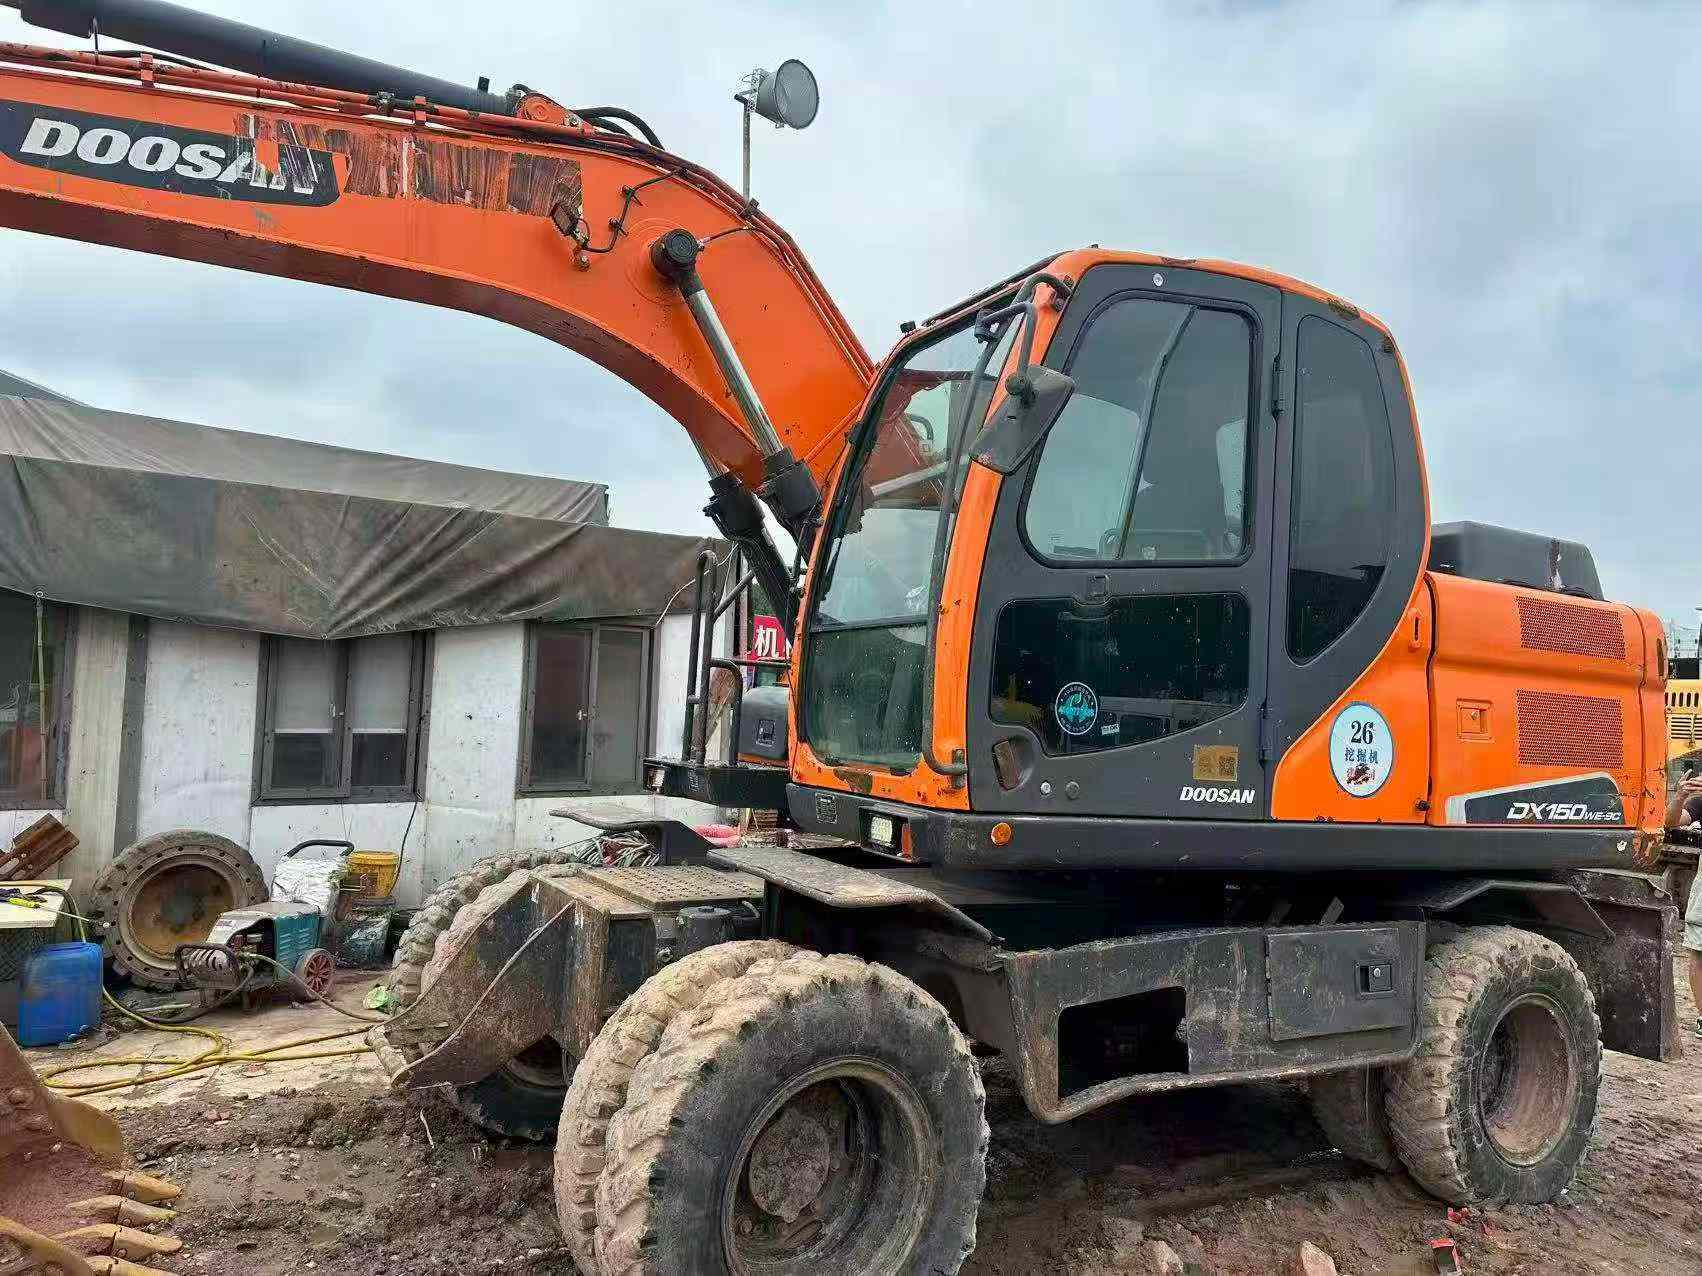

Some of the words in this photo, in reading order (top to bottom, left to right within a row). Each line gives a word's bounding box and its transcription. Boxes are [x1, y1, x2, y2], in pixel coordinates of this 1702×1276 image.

[1350, 720, 1374, 744] 26
[1344, 747, 1379, 764] 挖掘机
[1180, 786, 1256, 804] DOOSAN
